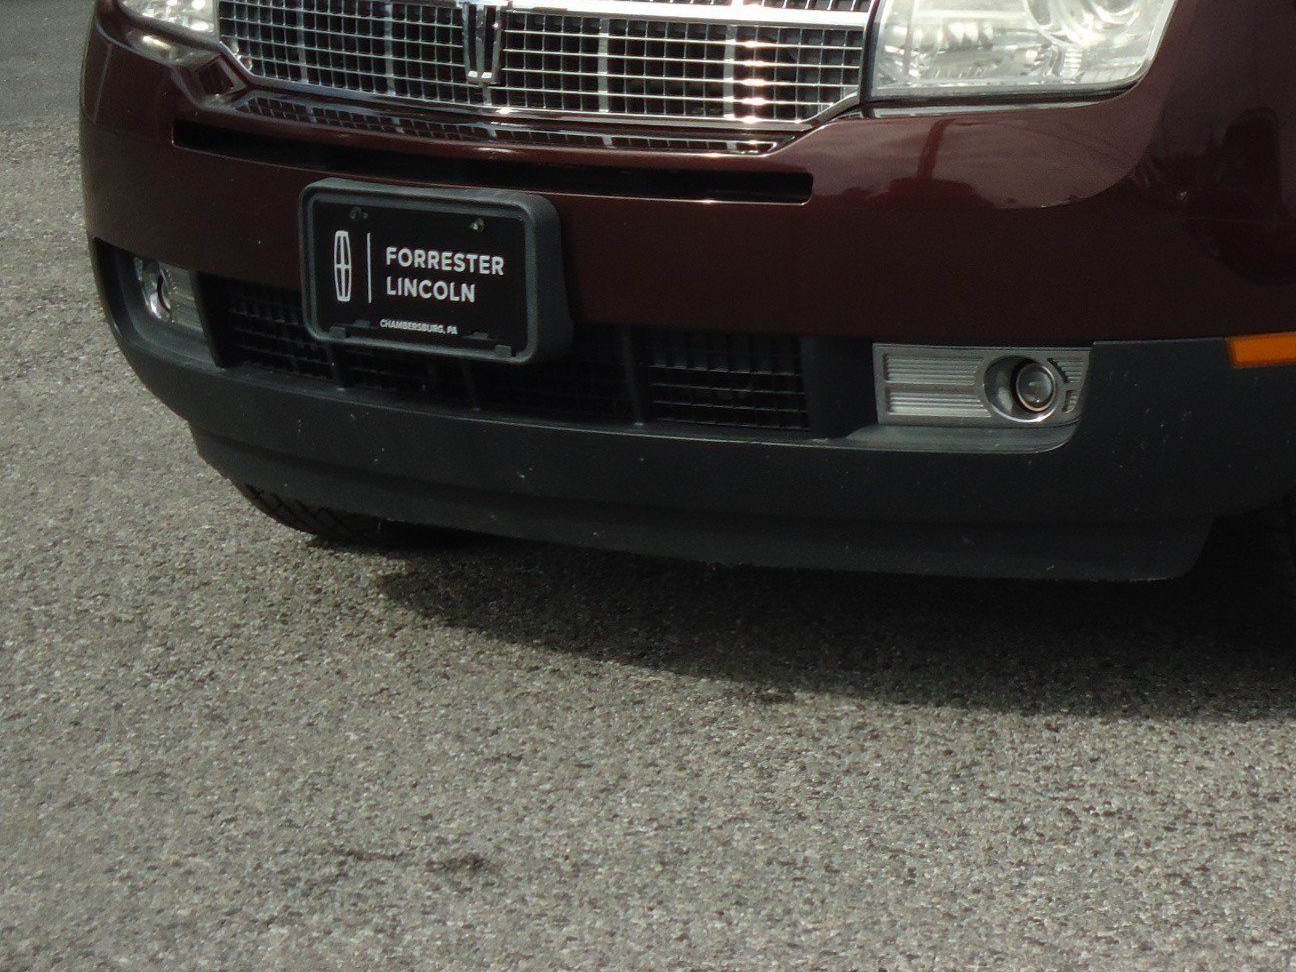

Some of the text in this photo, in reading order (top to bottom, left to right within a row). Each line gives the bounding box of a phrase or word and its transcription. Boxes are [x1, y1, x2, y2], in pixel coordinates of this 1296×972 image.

[386, 246, 505, 276] FORRESTER
[386, 276, 476, 303] LINCOLN
[447, 325, 458, 335] PA
